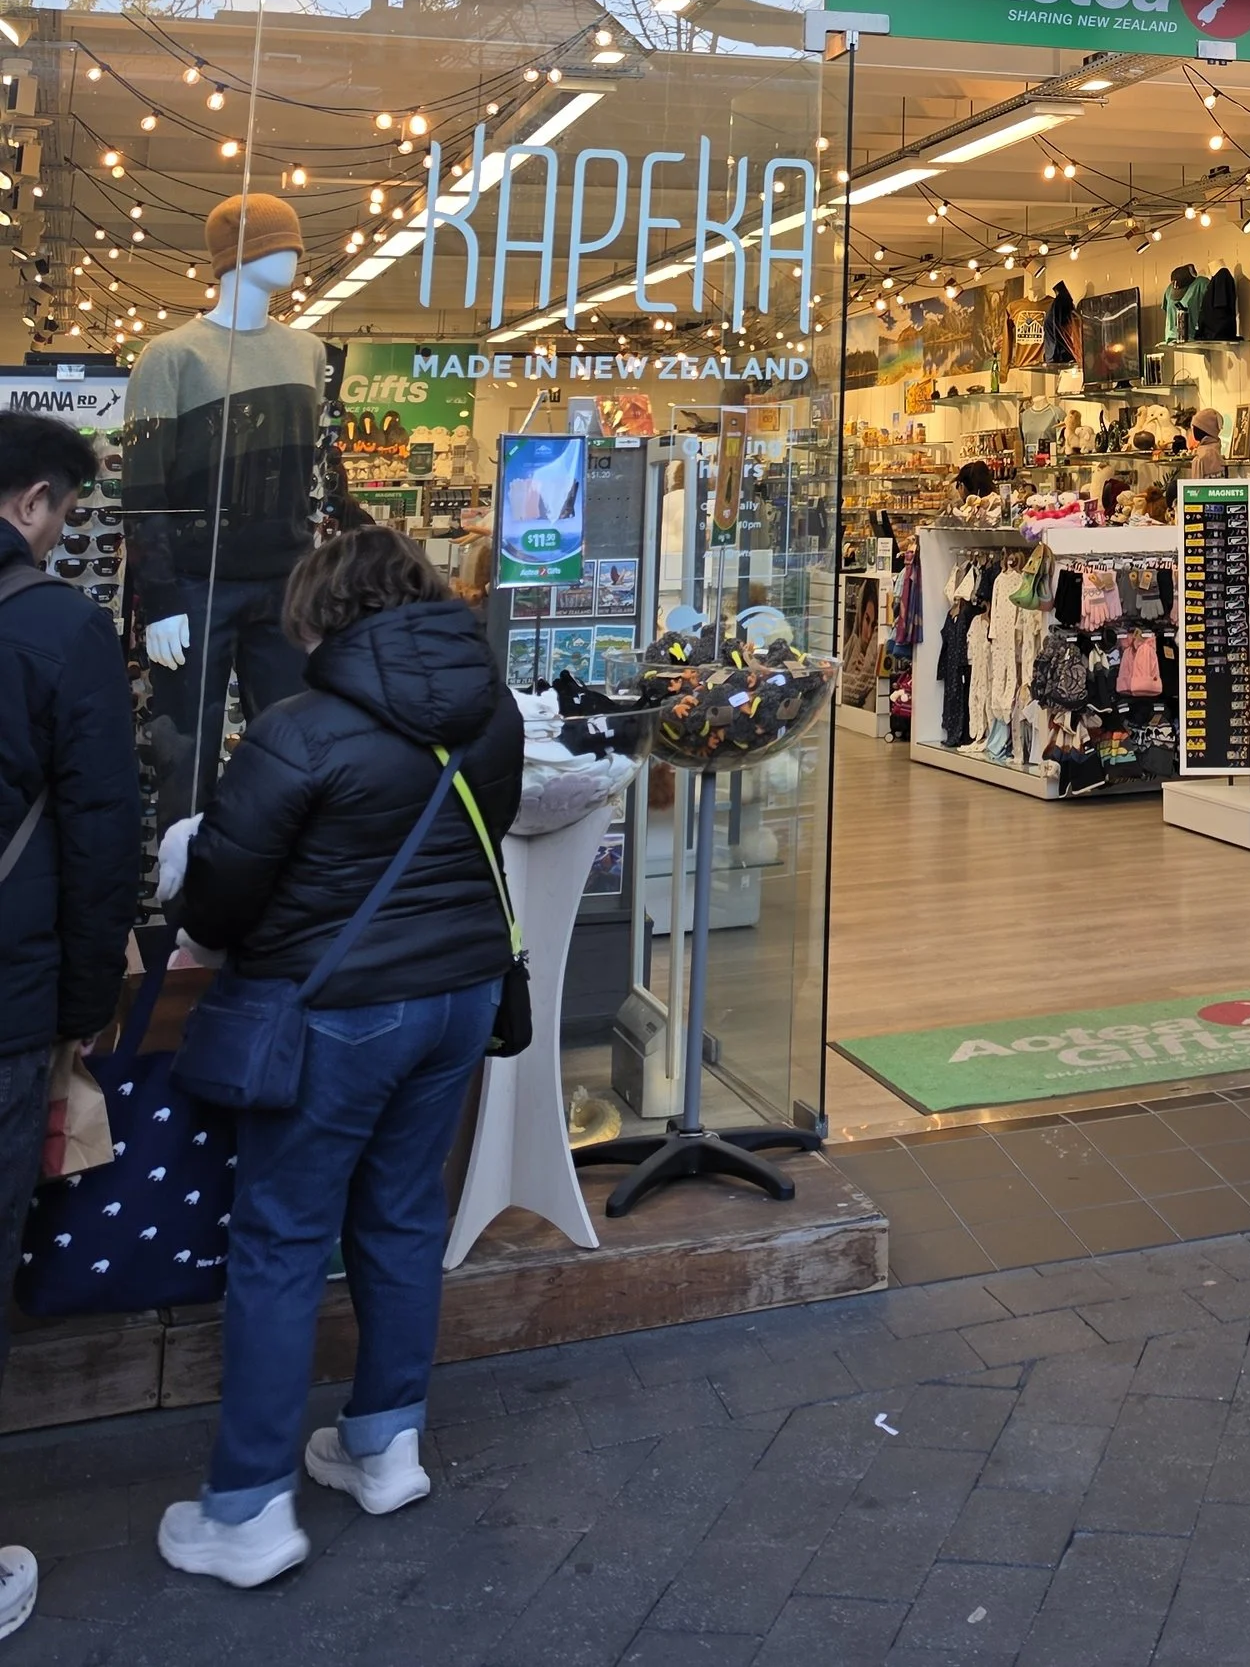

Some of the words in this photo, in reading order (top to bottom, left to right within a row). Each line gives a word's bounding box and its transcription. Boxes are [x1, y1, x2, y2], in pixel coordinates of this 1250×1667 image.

[1007, 9, 1073, 25] SHARING
[1077, 14, 1111, 28] NEW
[1113, 17, 1178, 33] ZEALAND
[419, 122, 815, 335] KAPEKA
[412, 354, 512, 379] MADE
[524, 355, 559, 380] IN
[570, 355, 648, 381] NEW
[657, 356, 809, 382] ZEALAND
[9, 390, 75, 412] MOANA
[77, 395, 98, 406] RD
[339, 374, 429, 404] Gifts
[682, 435, 784, 459] Oping
[698, 460, 765, 479] hrs
[1208, 488, 1244, 497] MAGNETS
[739, 501, 760, 511] aily
[948, 1018, 1204, 1063] Aotea
